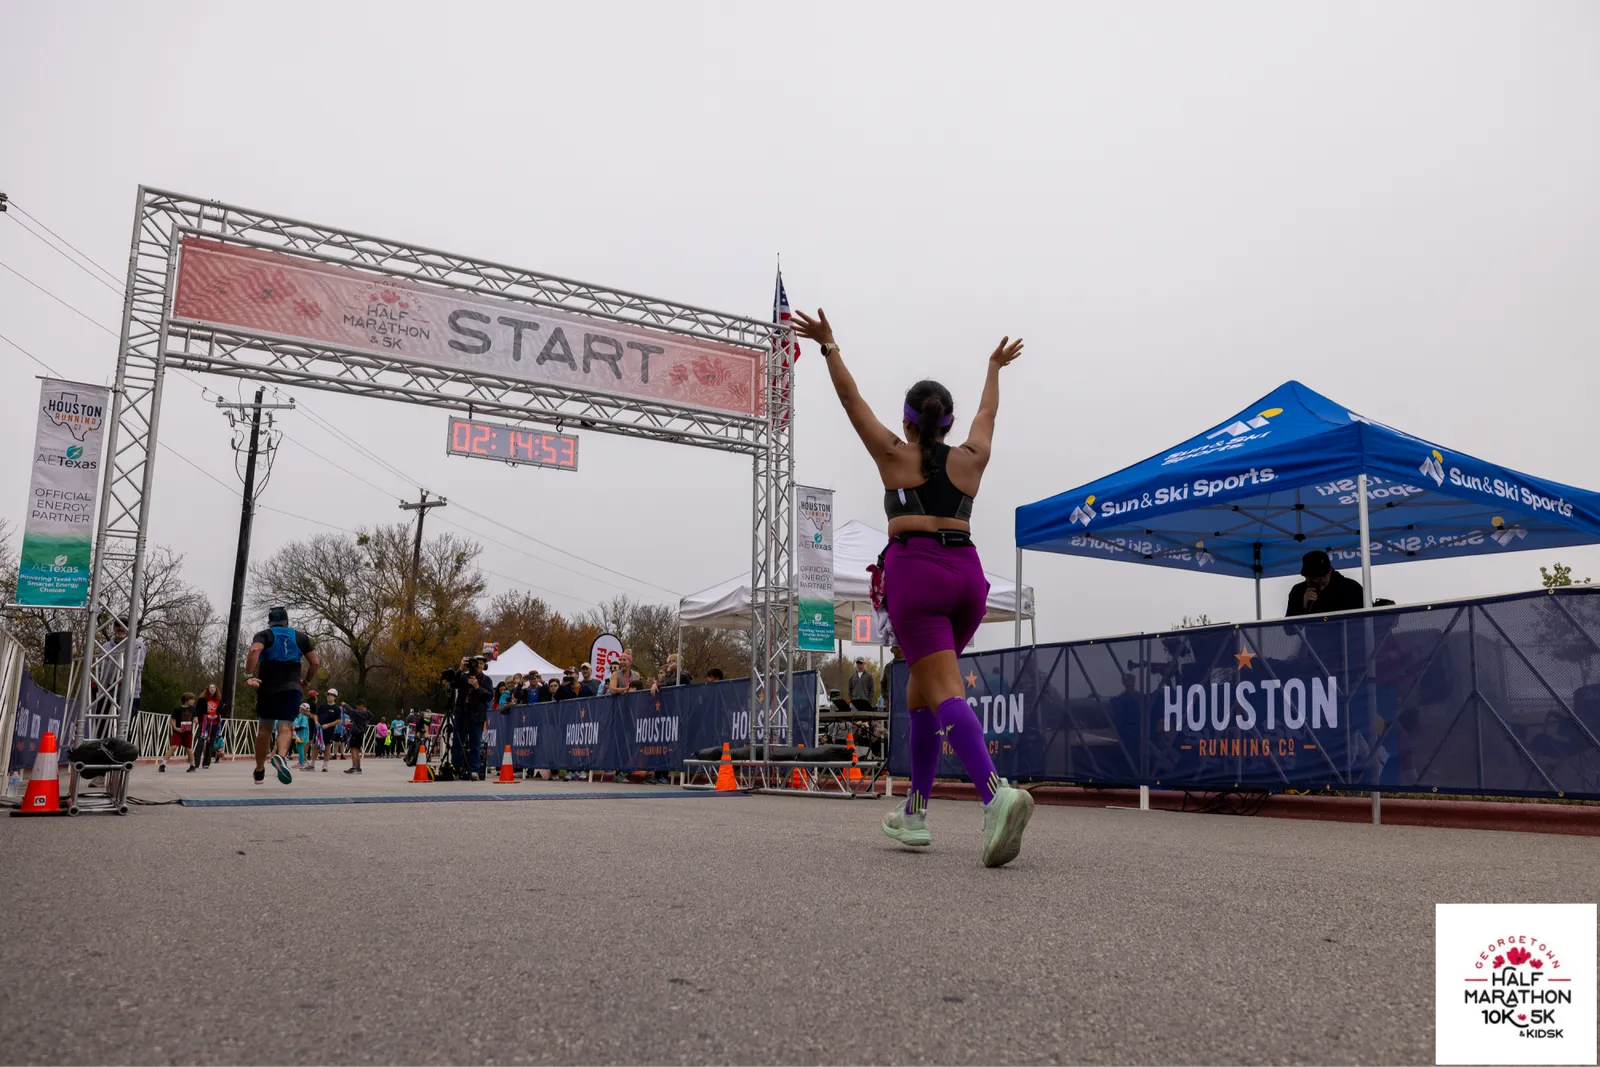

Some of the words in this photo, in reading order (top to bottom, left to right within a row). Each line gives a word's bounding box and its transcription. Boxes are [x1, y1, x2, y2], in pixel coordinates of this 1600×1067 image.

[367, 303, 409, 321] HALF
[343, 314, 430, 340] MARATHON
[370, 335, 379, 344] &
[382, 336, 403, 350] 5K
[447, 309, 665, 384] START
[48, 399, 102, 418] HOUSTON
[55, 412, 97, 425] RUNNING
[1192, 467, 1276, 498] Sports
[35, 487, 92, 502] OFFICIAL
[1520, 487, 1573, 518] Sports
[37, 499, 88, 512] ENERGY
[800, 501, 831, 513] HOUSTON
[32, 509, 91, 523] PARTNER
[20, 574, 52, 582] Powering
[800, 565, 831, 574] OFFICIAL
[801, 574, 831, 582] ENERGY
[27, 580, 55, 588] Smarter
[800, 582, 833, 590] PARTNER
[595, 647, 607, 680] FIRST
[1163, 676, 1338, 732] HOUSTON
[512, 726, 538, 746] HOUSTON
[566, 722, 599, 745] HOUSTON
[635, 715, 679, 743] HOUSTON
[1199, 738, 1270, 757] RUNNING
